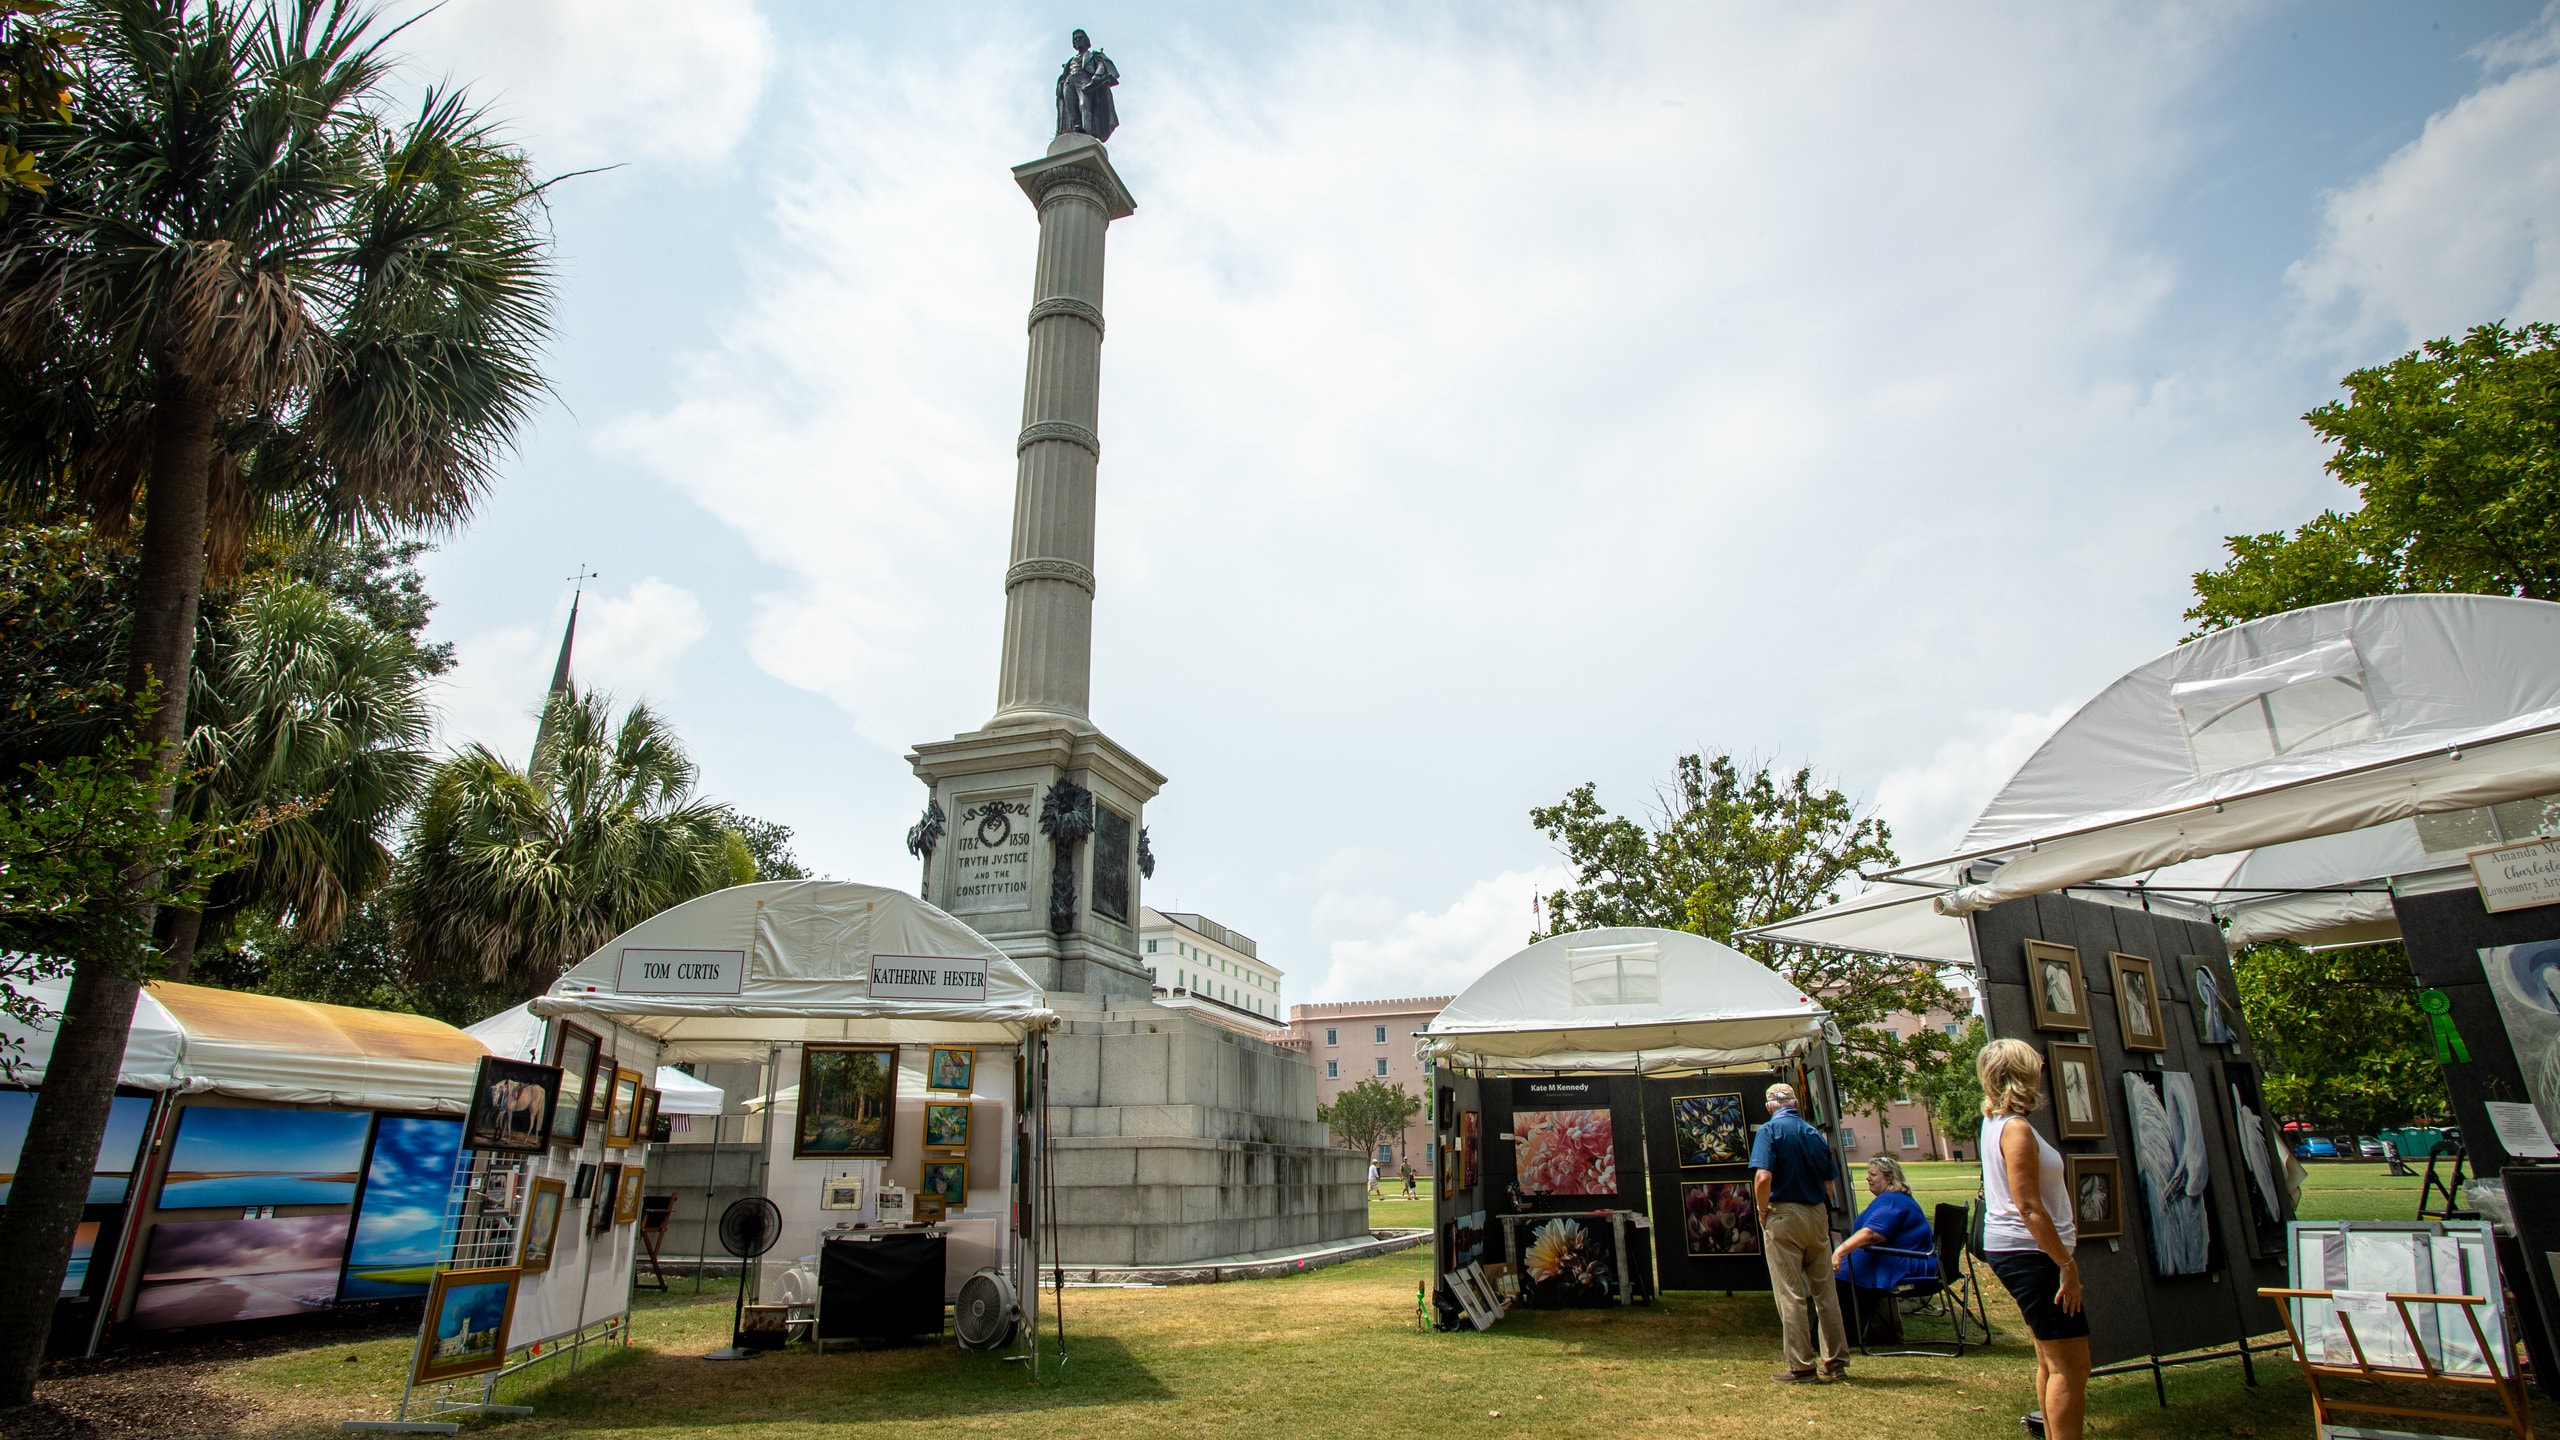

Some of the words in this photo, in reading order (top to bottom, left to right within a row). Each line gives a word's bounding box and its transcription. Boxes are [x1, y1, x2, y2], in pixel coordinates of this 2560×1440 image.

[960, 837, 979, 851] 1782
[1009, 833, 1030, 846] 1850
[2491, 846, 2538, 863] Amanda
[975, 872, 990, 880] AND
[994, 870, 1010, 878] THE
[2483, 881, 2539, 897] Lowcountry
[644, 962, 671, 979] TOM
[677, 963, 720, 980] CURTIS
[873, 968, 937, 985] KATHERINE
[942, 970, 985, 987] HESTER
[1530, 1084, 1548, 1092] Kate
[1556, 1083, 1589, 1092] Kennedy
